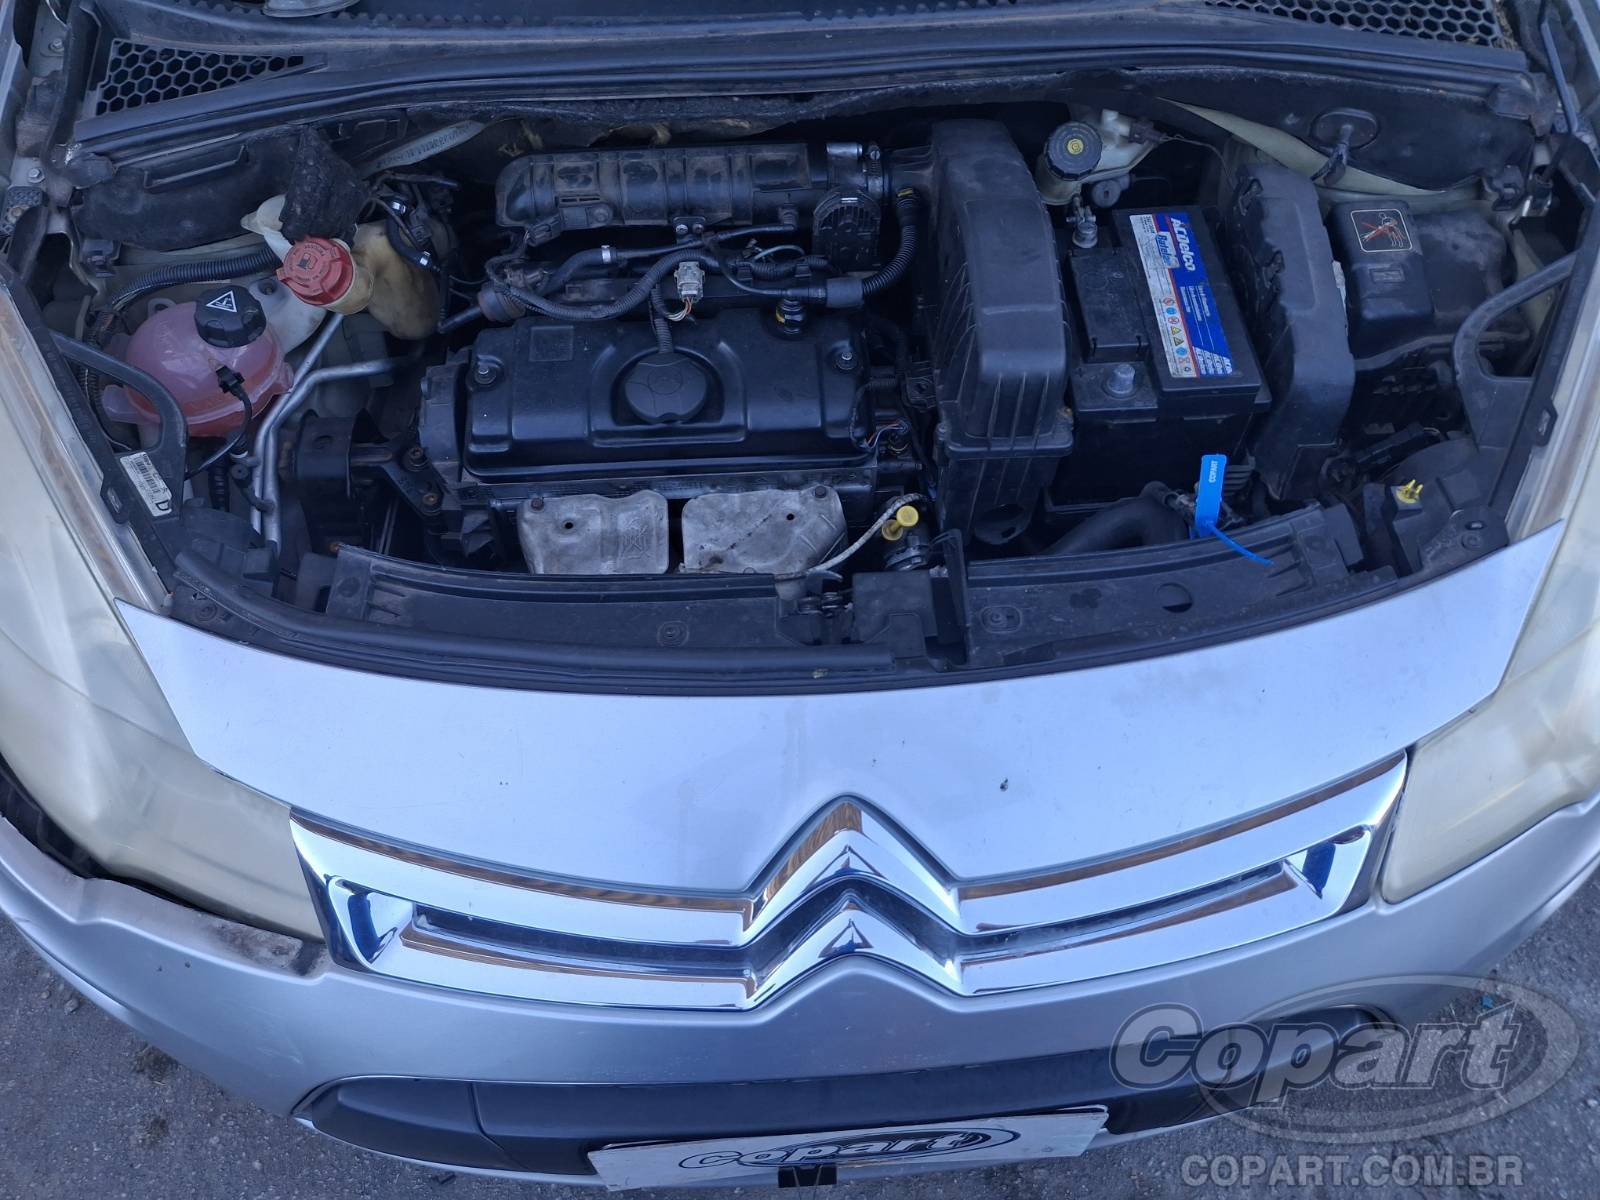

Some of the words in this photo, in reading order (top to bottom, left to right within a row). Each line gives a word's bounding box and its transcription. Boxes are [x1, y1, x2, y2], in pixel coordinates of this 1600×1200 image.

[1170, 217, 1196, 271] ACDelco
[1208, 460, 1218, 483] COPART
[678, 1131, 970, 1169] Copart
